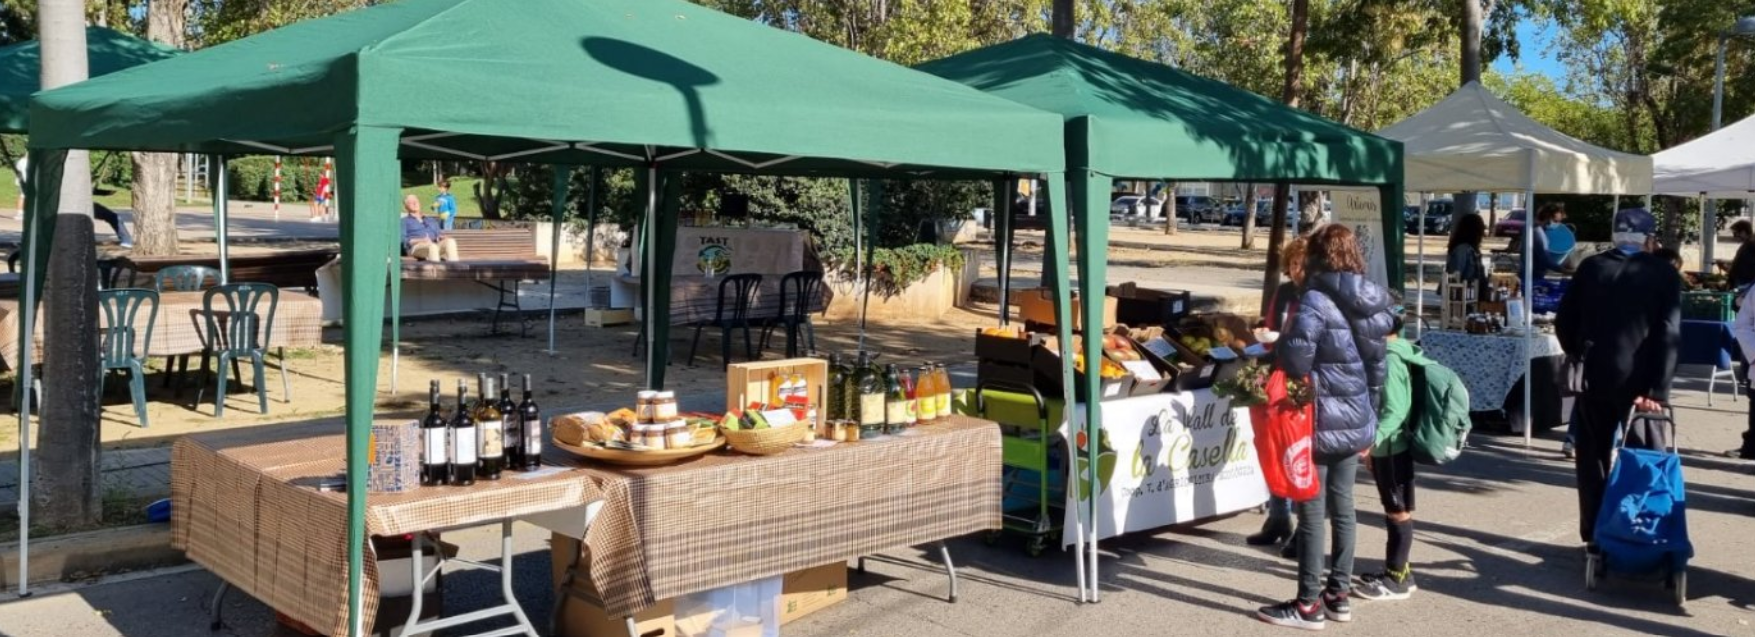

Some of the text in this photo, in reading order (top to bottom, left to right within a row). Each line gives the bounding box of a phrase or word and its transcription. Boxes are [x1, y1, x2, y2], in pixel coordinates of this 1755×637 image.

[700, 236, 729, 246] TAST
[1148, 402, 1238, 437] La Vall de
[1132, 438, 1155, 478] la
[1168, 427, 1247, 471] Casella
